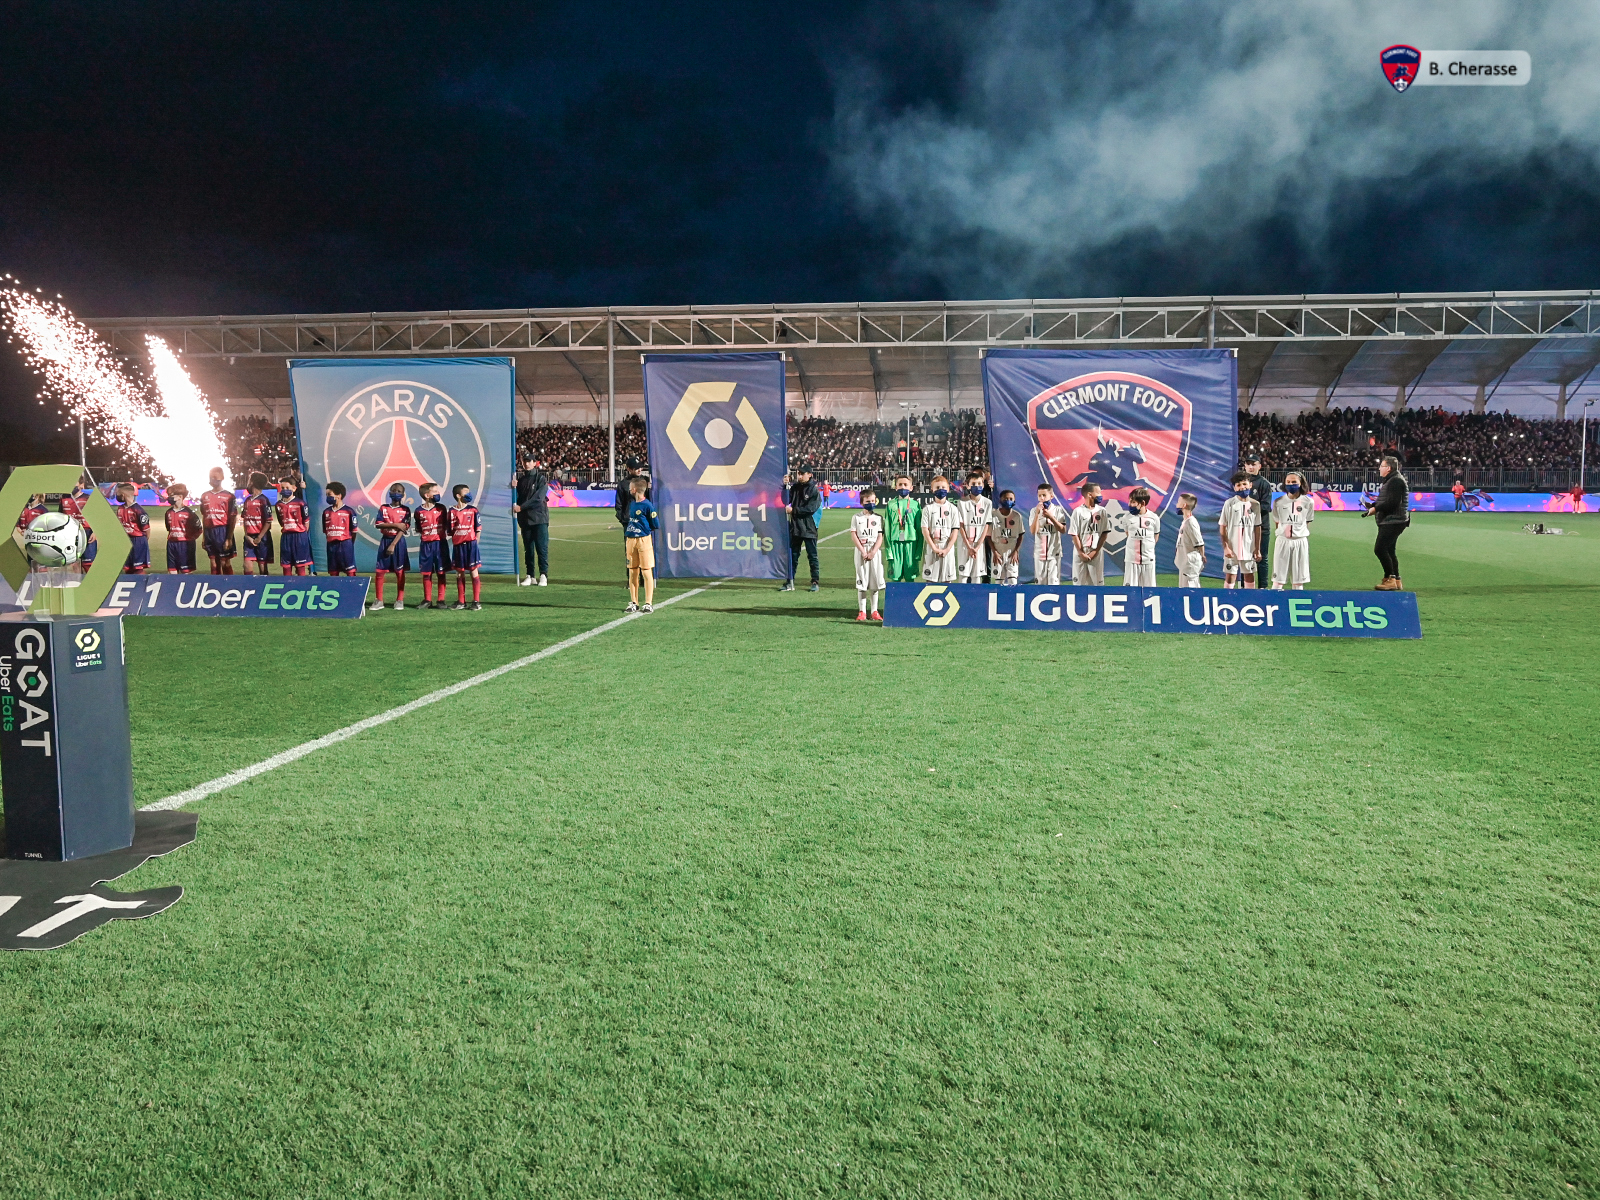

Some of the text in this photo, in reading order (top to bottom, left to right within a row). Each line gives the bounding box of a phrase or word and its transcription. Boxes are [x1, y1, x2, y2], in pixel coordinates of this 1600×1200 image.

[345, 389, 453, 430] PARIS
[1042, 383, 1178, 419] CLERMONT FOOT
[1326, 483, 1354, 492] AZUR
[674, 503, 767, 522] LIGUE 1
[667, 531, 774, 552] Uber Eats
[145, 581, 162, 608] 1
[175, 582, 255, 610] Uber
[258, 583, 340, 610] Eats
[988, 592, 1389, 630] LIGUE 1 Uber Eats
[0, 655, 15, 732] Uber Eats
[14, 628, 51, 757] GOAT
